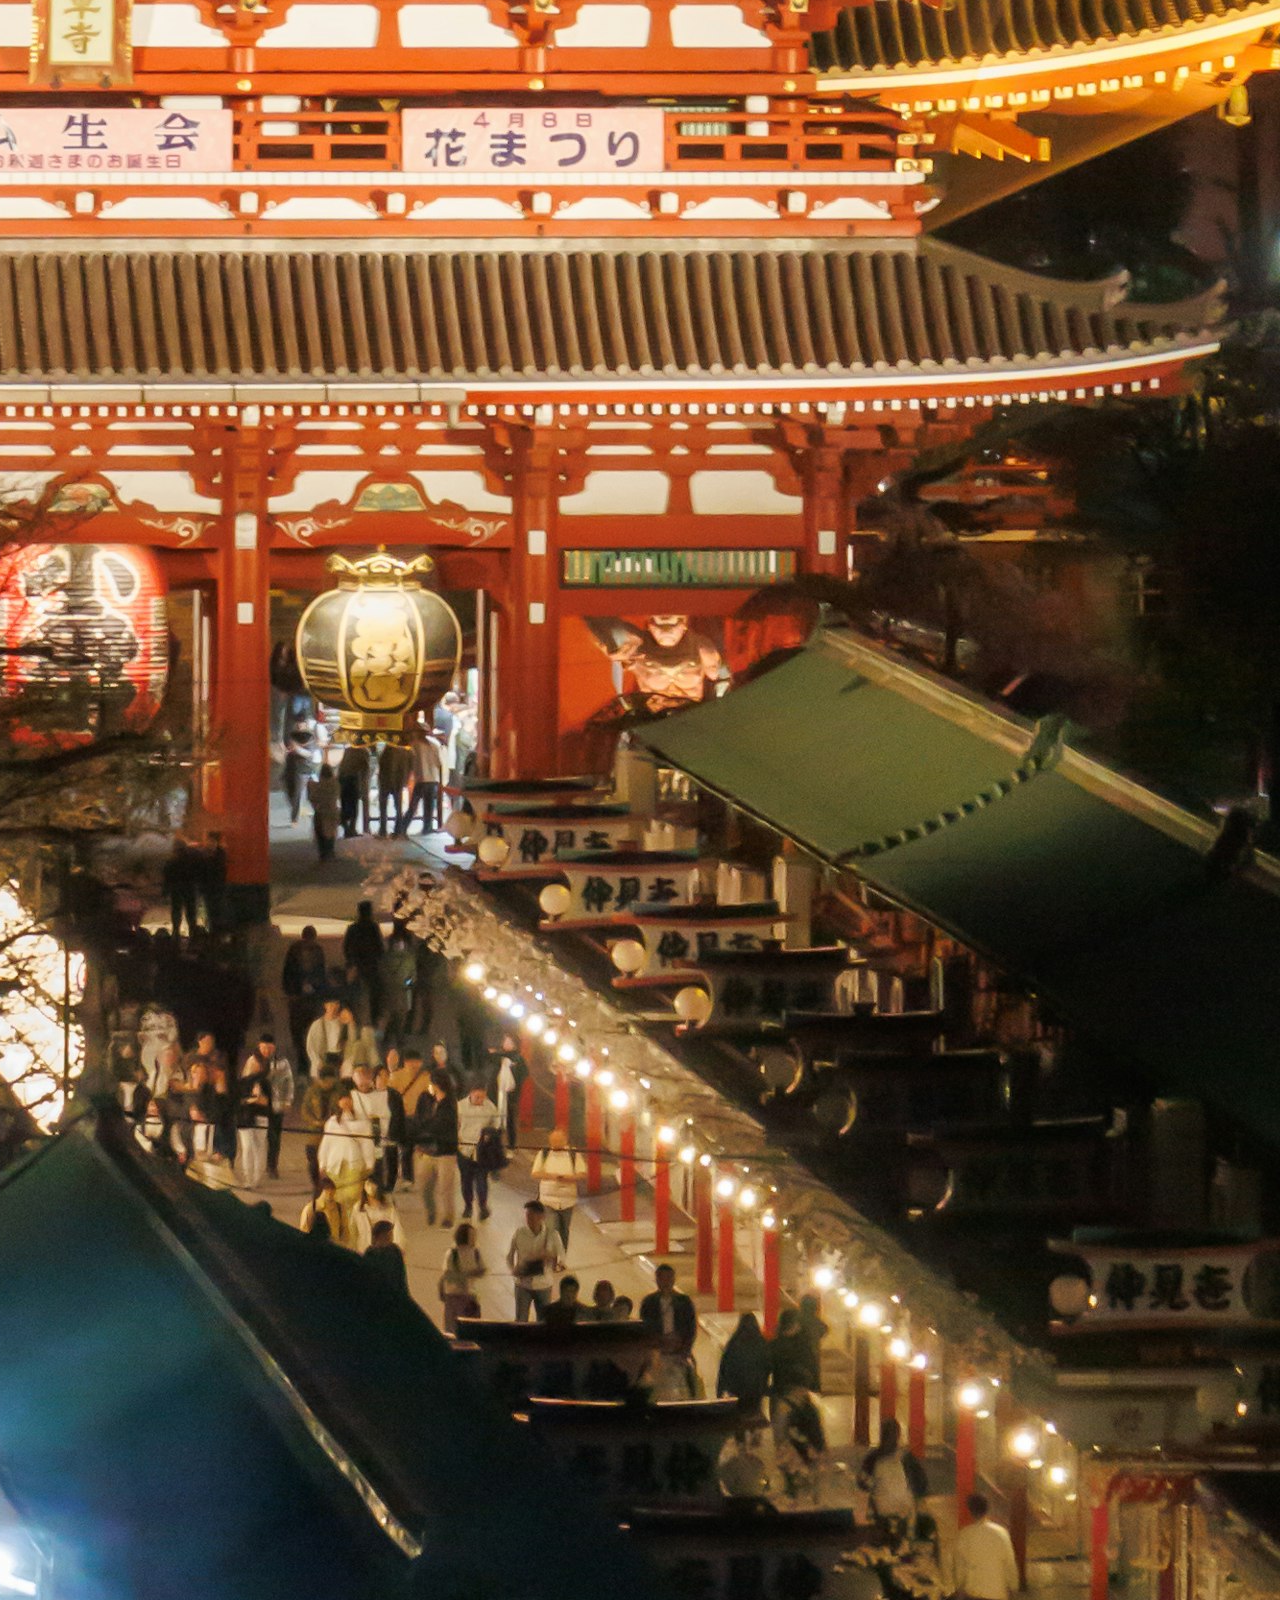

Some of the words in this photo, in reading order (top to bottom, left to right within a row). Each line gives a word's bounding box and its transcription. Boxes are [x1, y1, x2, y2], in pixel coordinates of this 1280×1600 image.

[472, 111, 593, 129] 4月8日
[424, 127, 641, 168] 花まつり
